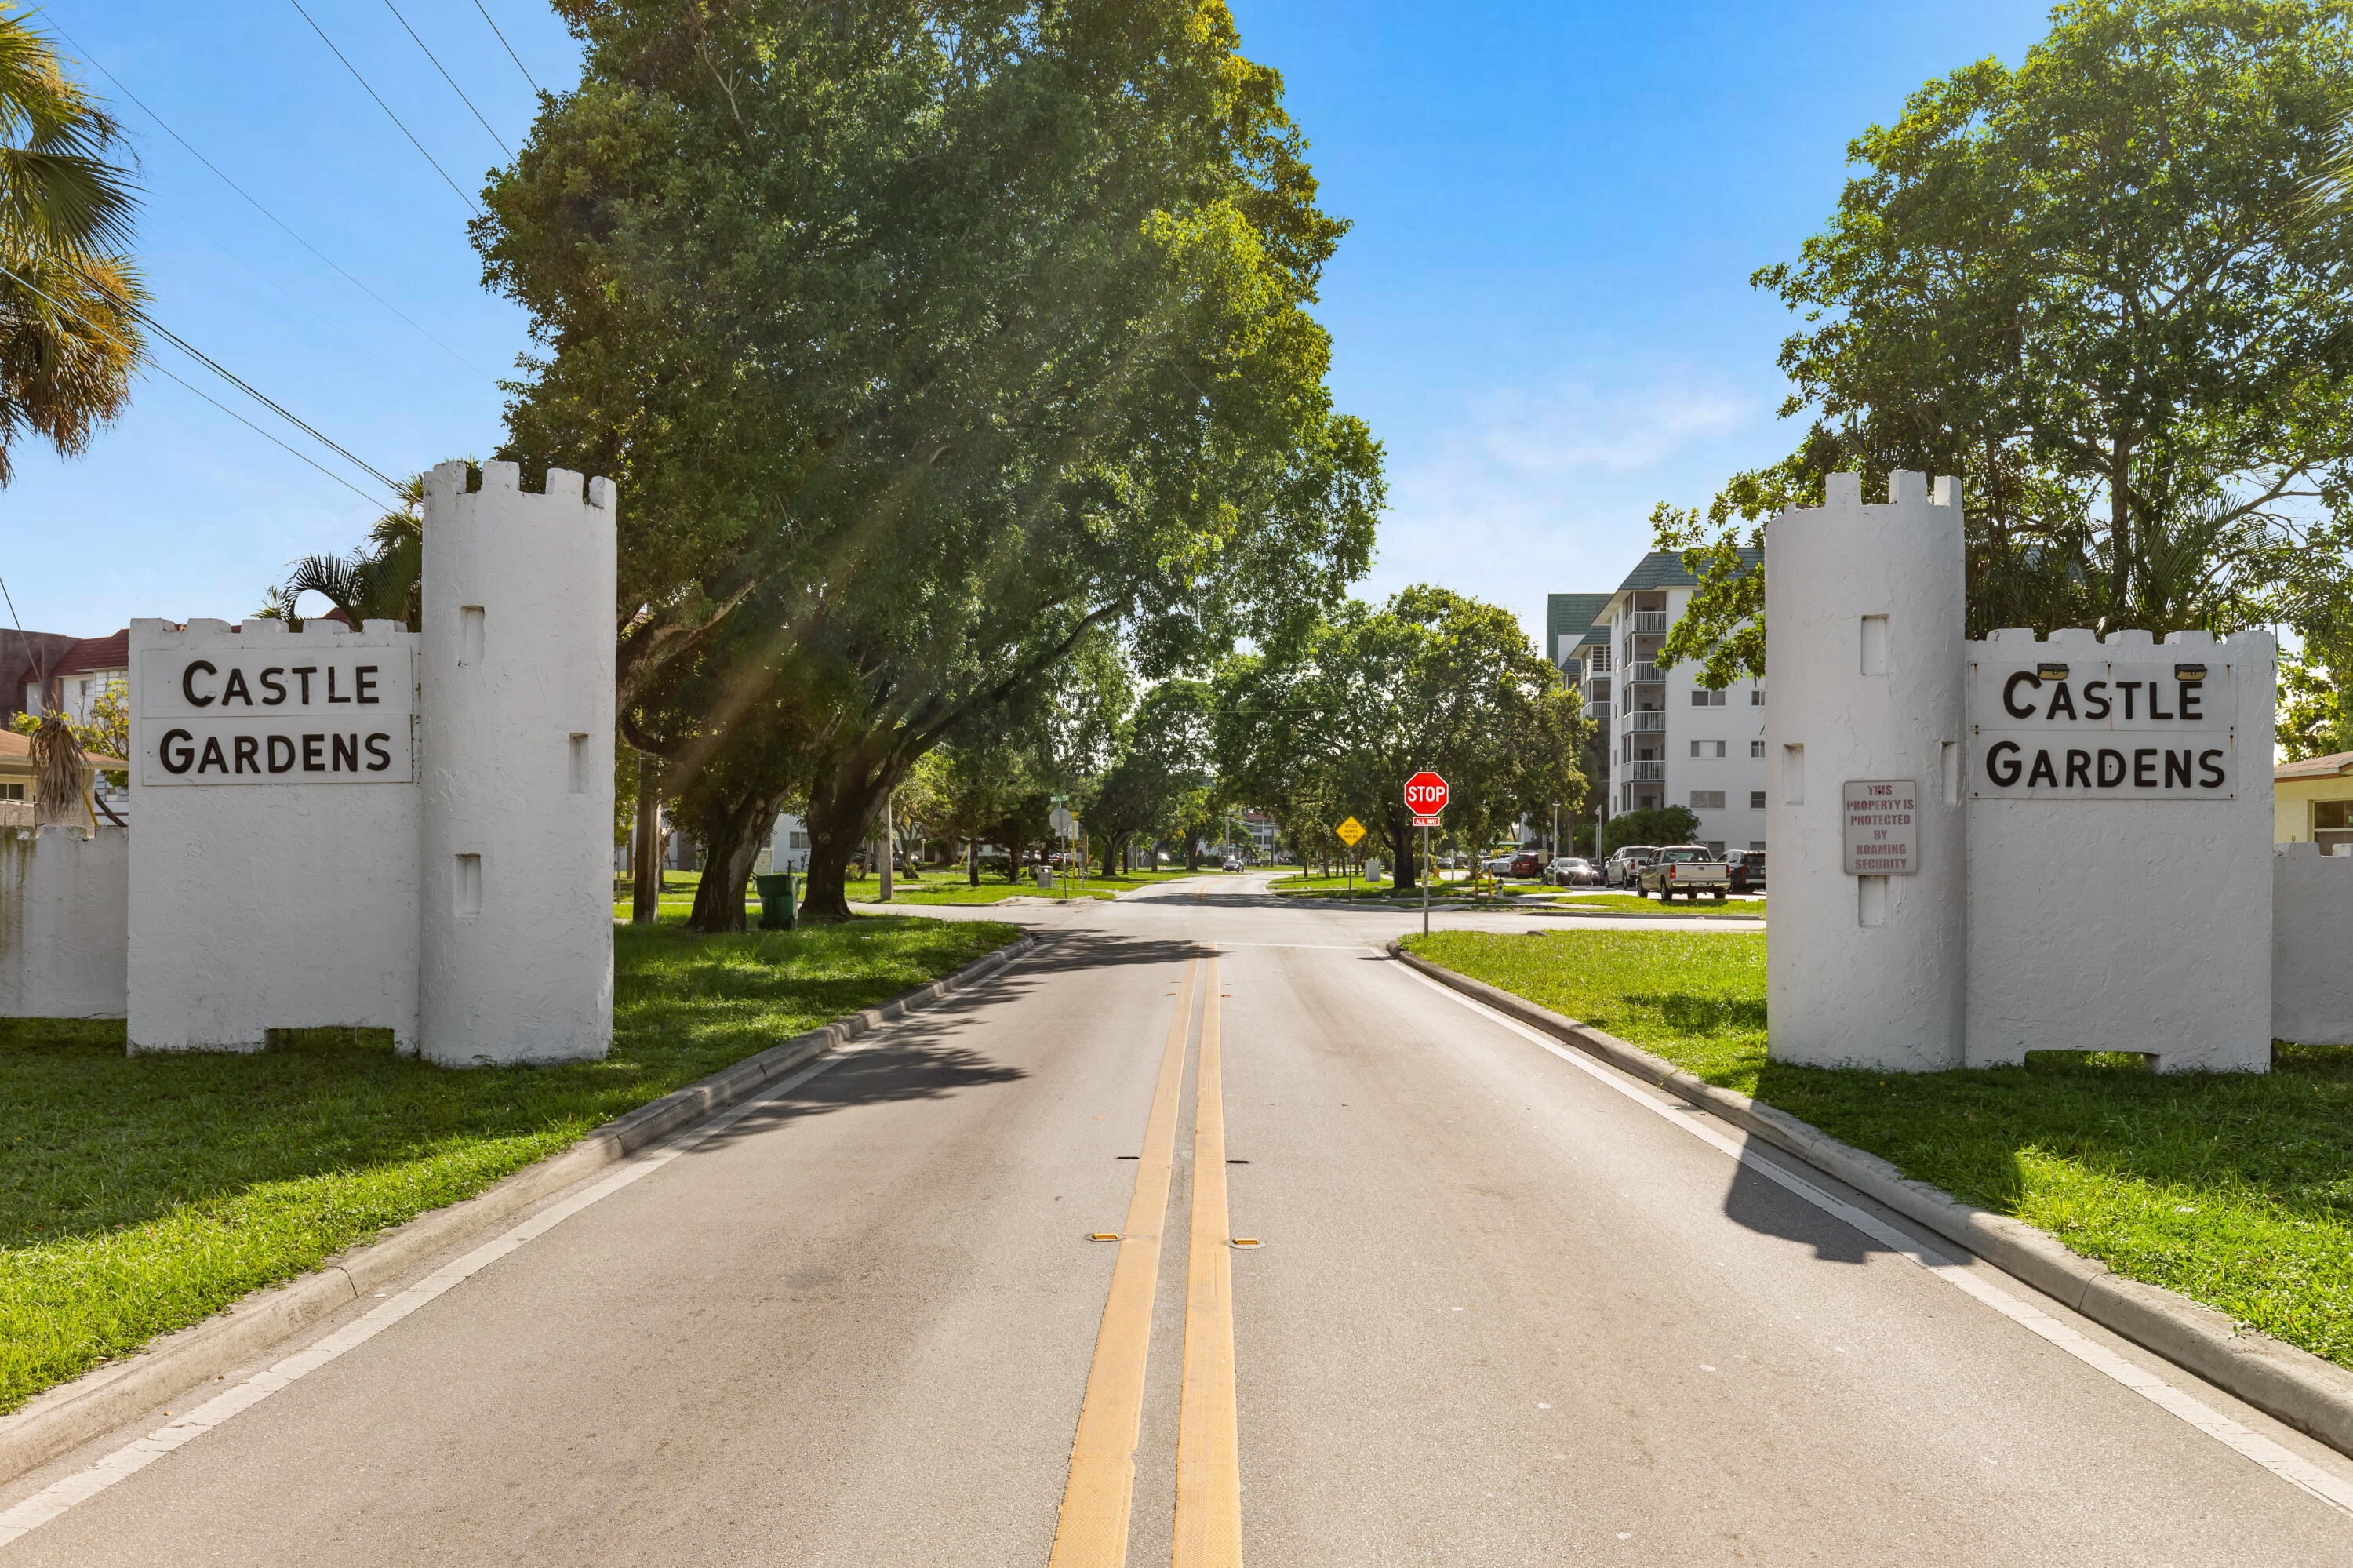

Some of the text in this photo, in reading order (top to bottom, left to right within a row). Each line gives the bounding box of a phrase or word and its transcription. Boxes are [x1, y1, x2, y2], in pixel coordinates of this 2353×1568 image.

[182, 660, 380, 708] CASTLE
[2003, 671, 2203, 720] CASTLE
[159, 728, 391, 775] GARDENS
[1986, 740, 2226, 788] GARDENS
[1407, 785, 1446, 802] STOP
[1867, 784, 1893, 796] THIS
[1846, 799, 1914, 811] PROPERTY IS
[1850, 814, 1911, 826] PROTECTED
[1873, 829, 1888, 841] BY
[1856, 843, 1907, 855] ROAMING
[1855, 858, 1907, 870] SECURITY
